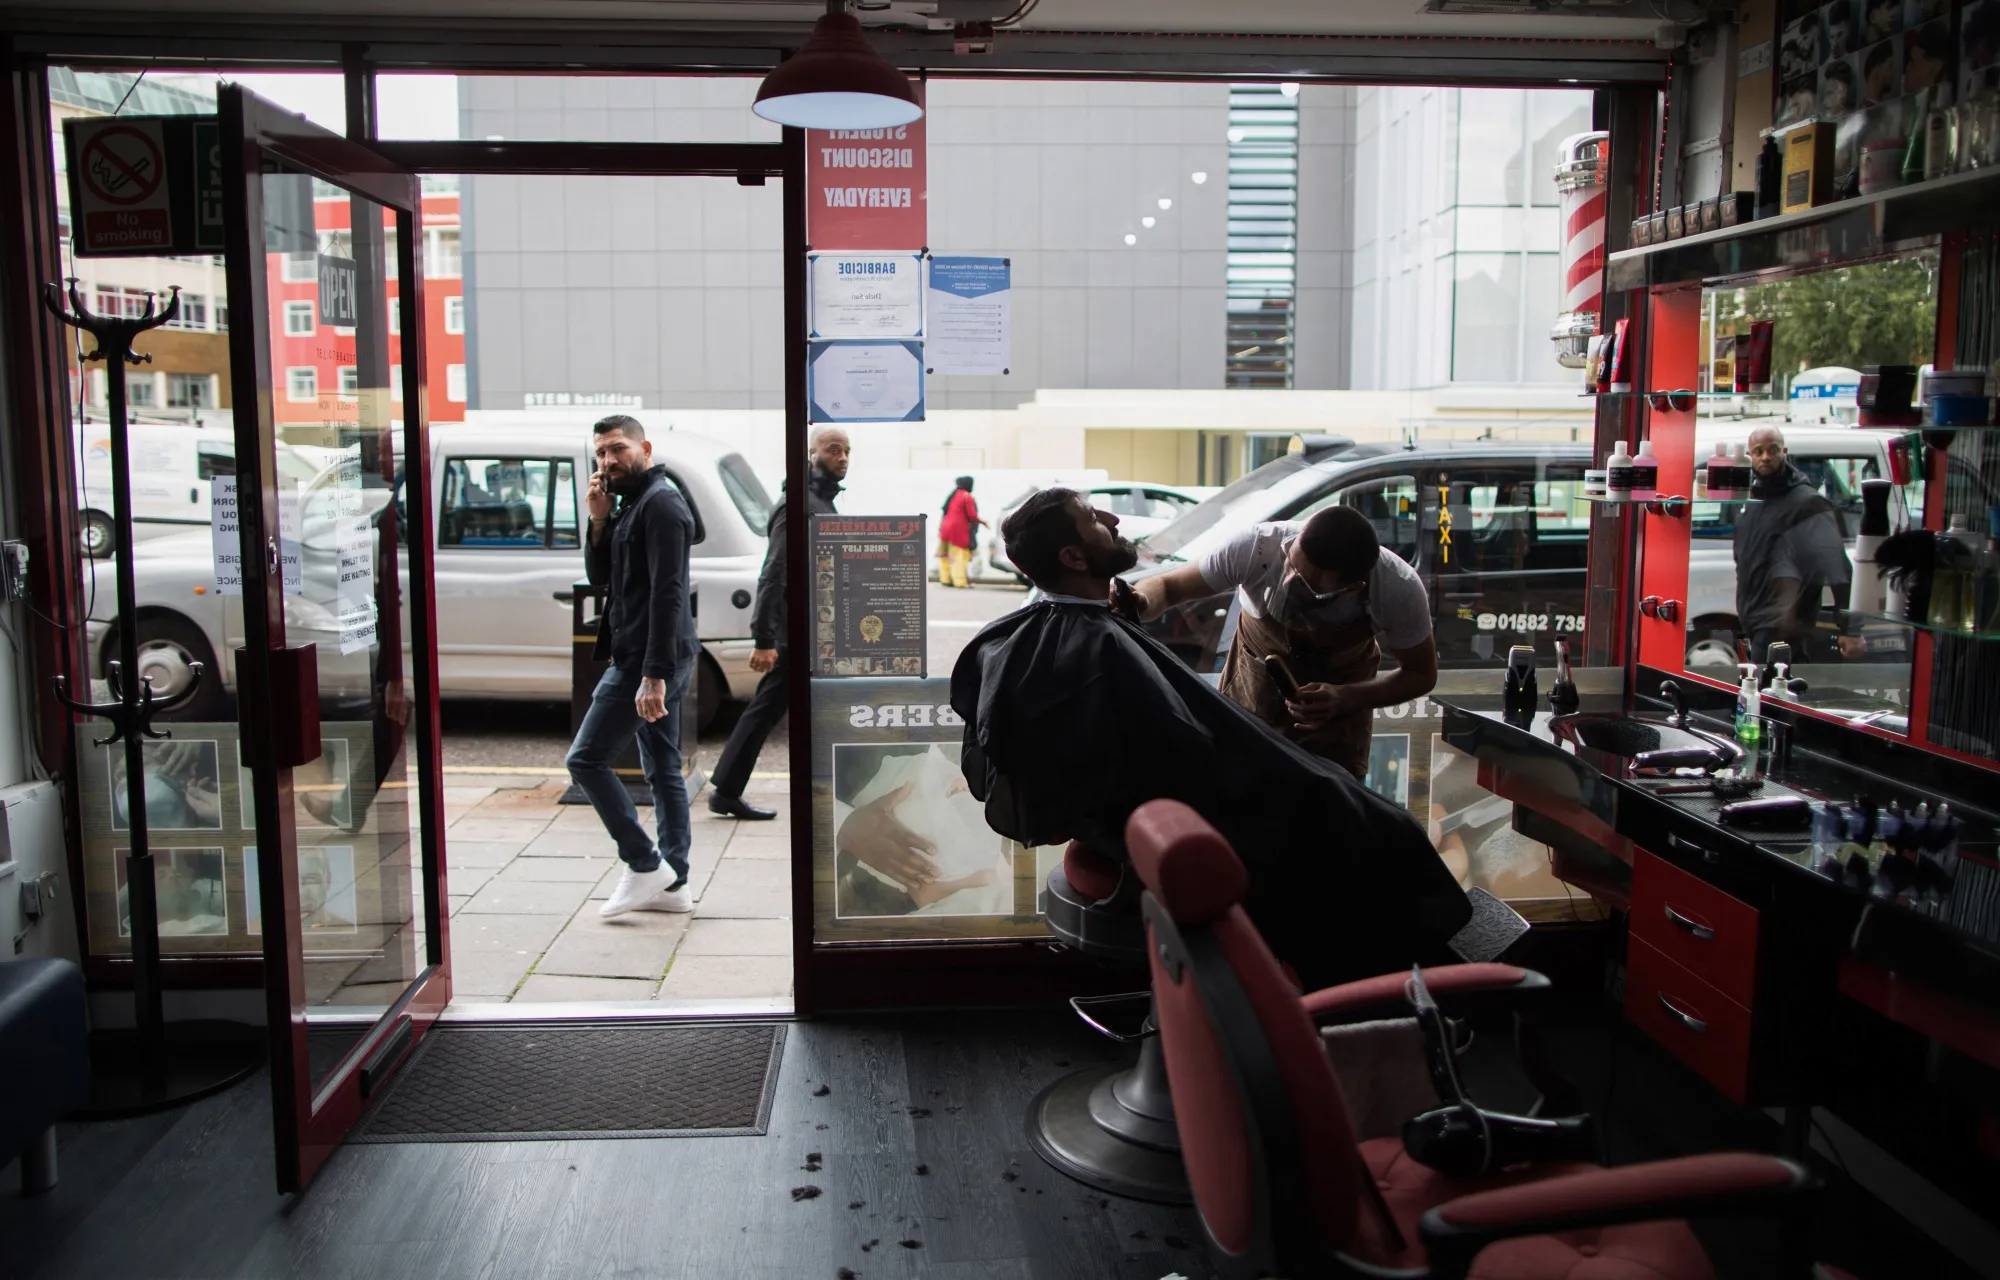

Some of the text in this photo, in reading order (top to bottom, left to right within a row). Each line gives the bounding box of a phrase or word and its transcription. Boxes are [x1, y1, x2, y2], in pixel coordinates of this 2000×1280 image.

[116, 212, 139, 226] No
[95, 227, 162, 243] smoking
[320, 265, 356, 320] OPEN
[524, 392, 643, 409] STEM building
[1438, 486, 1452, 564] TAXI
[1497, 613, 1548, 631] 01582
